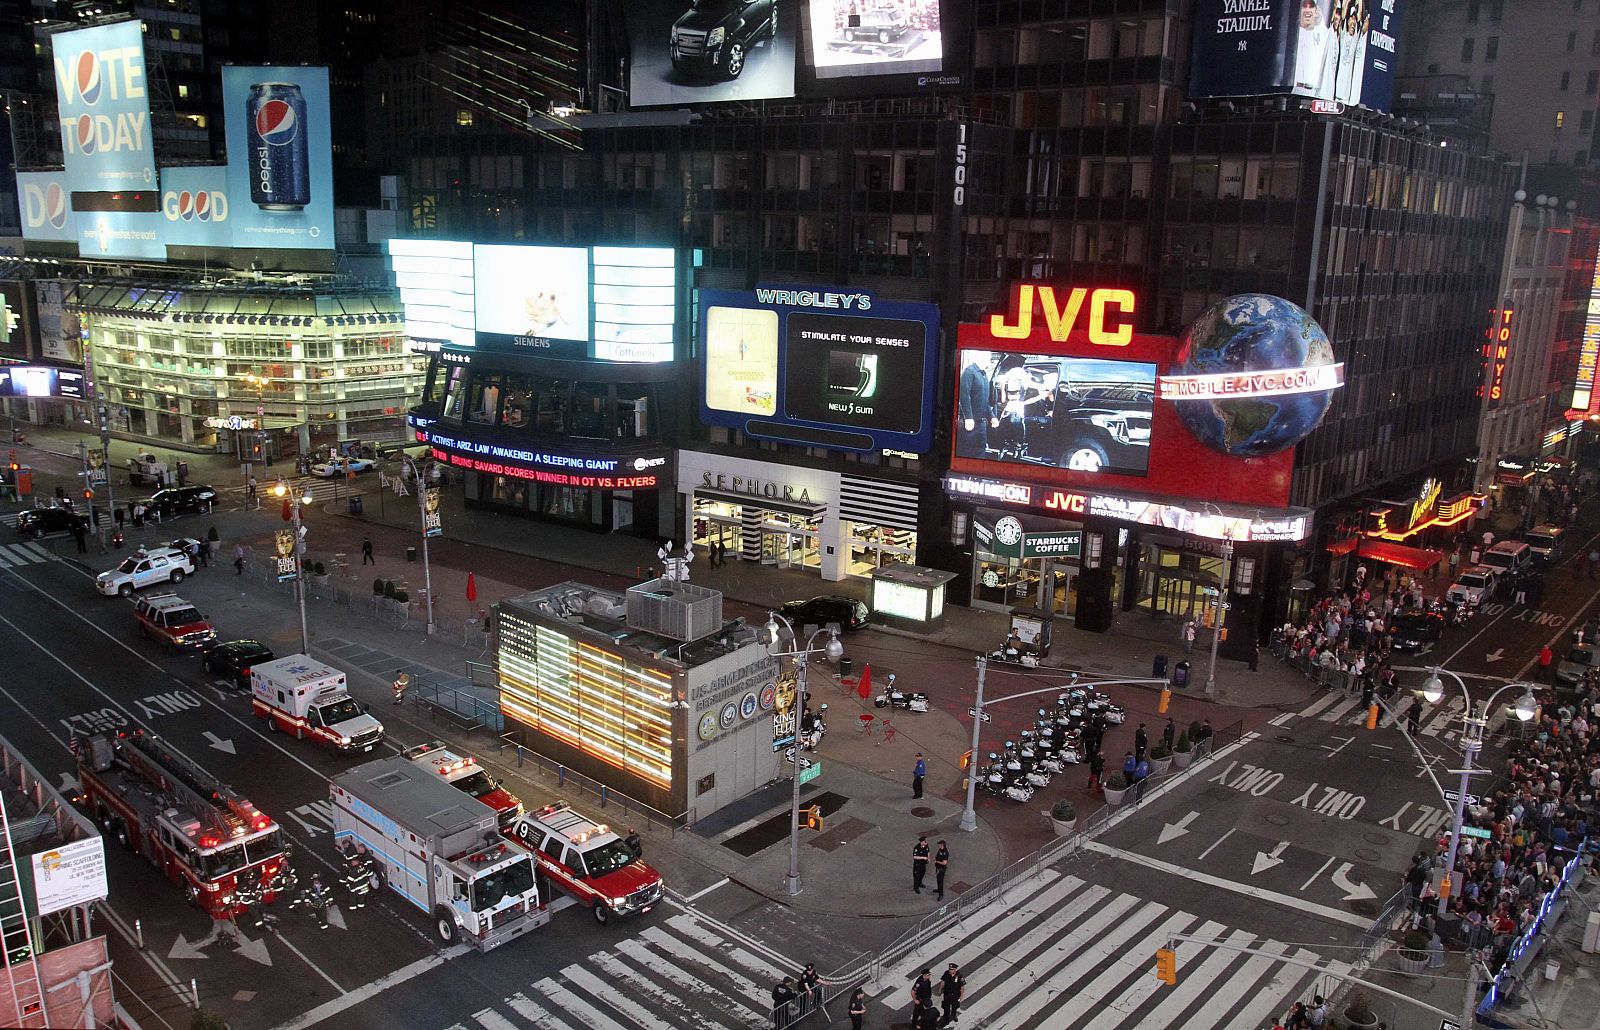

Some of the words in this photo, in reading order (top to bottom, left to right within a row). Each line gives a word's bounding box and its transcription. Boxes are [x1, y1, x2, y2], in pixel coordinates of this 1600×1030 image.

[1216, 15, 1273, 34] STADIUM.
[1315, 101, 1339, 112] FUEL
[257, 147, 273, 193] pepsi
[756, 288, 872, 310] WRIGLEY'S
[990, 284, 1136, 347] JVC
[514, 336, 551, 349] SIEMENS
[801, 331, 847, 342] STIMULATE
[850, 335, 872, 344] YOUR
[876, 337, 909, 347] SENSES
[828, 402, 847, 412] NEW
[855, 406, 873, 415] GUM
[432, 434, 456, 448] ACTIVIST:
[474, 443, 490, 454] LAW
[535, 454, 541, 462] A
[543, 455, 583, 468] SLEEPING
[474, 460, 502, 474] SAVARD
[504, 466, 534, 480] SCORES
[536, 471, 569, 485] WINNER
[570, 475, 580, 486] IN
[581, 476, 595, 487] OT
[597, 476, 614, 487] VS.
[618, 476, 656, 487] FLYERS
[702, 471, 812, 504] SEPHORA
[948, 478, 984, 495] TURN
[1046, 492, 1085, 513] JVC
[1026, 536, 1080, 547] STARBUCKS
[1035, 544, 1069, 553] COFFEE
[133, 690, 201, 719] ONLY
[773, 710, 795, 726] KING
[1208, 760, 1285, 797] ONLY
[1290, 782, 1366, 820] ONLY
[520, 822, 529, 838] 9
[1379, 801, 1453, 839] NLY
